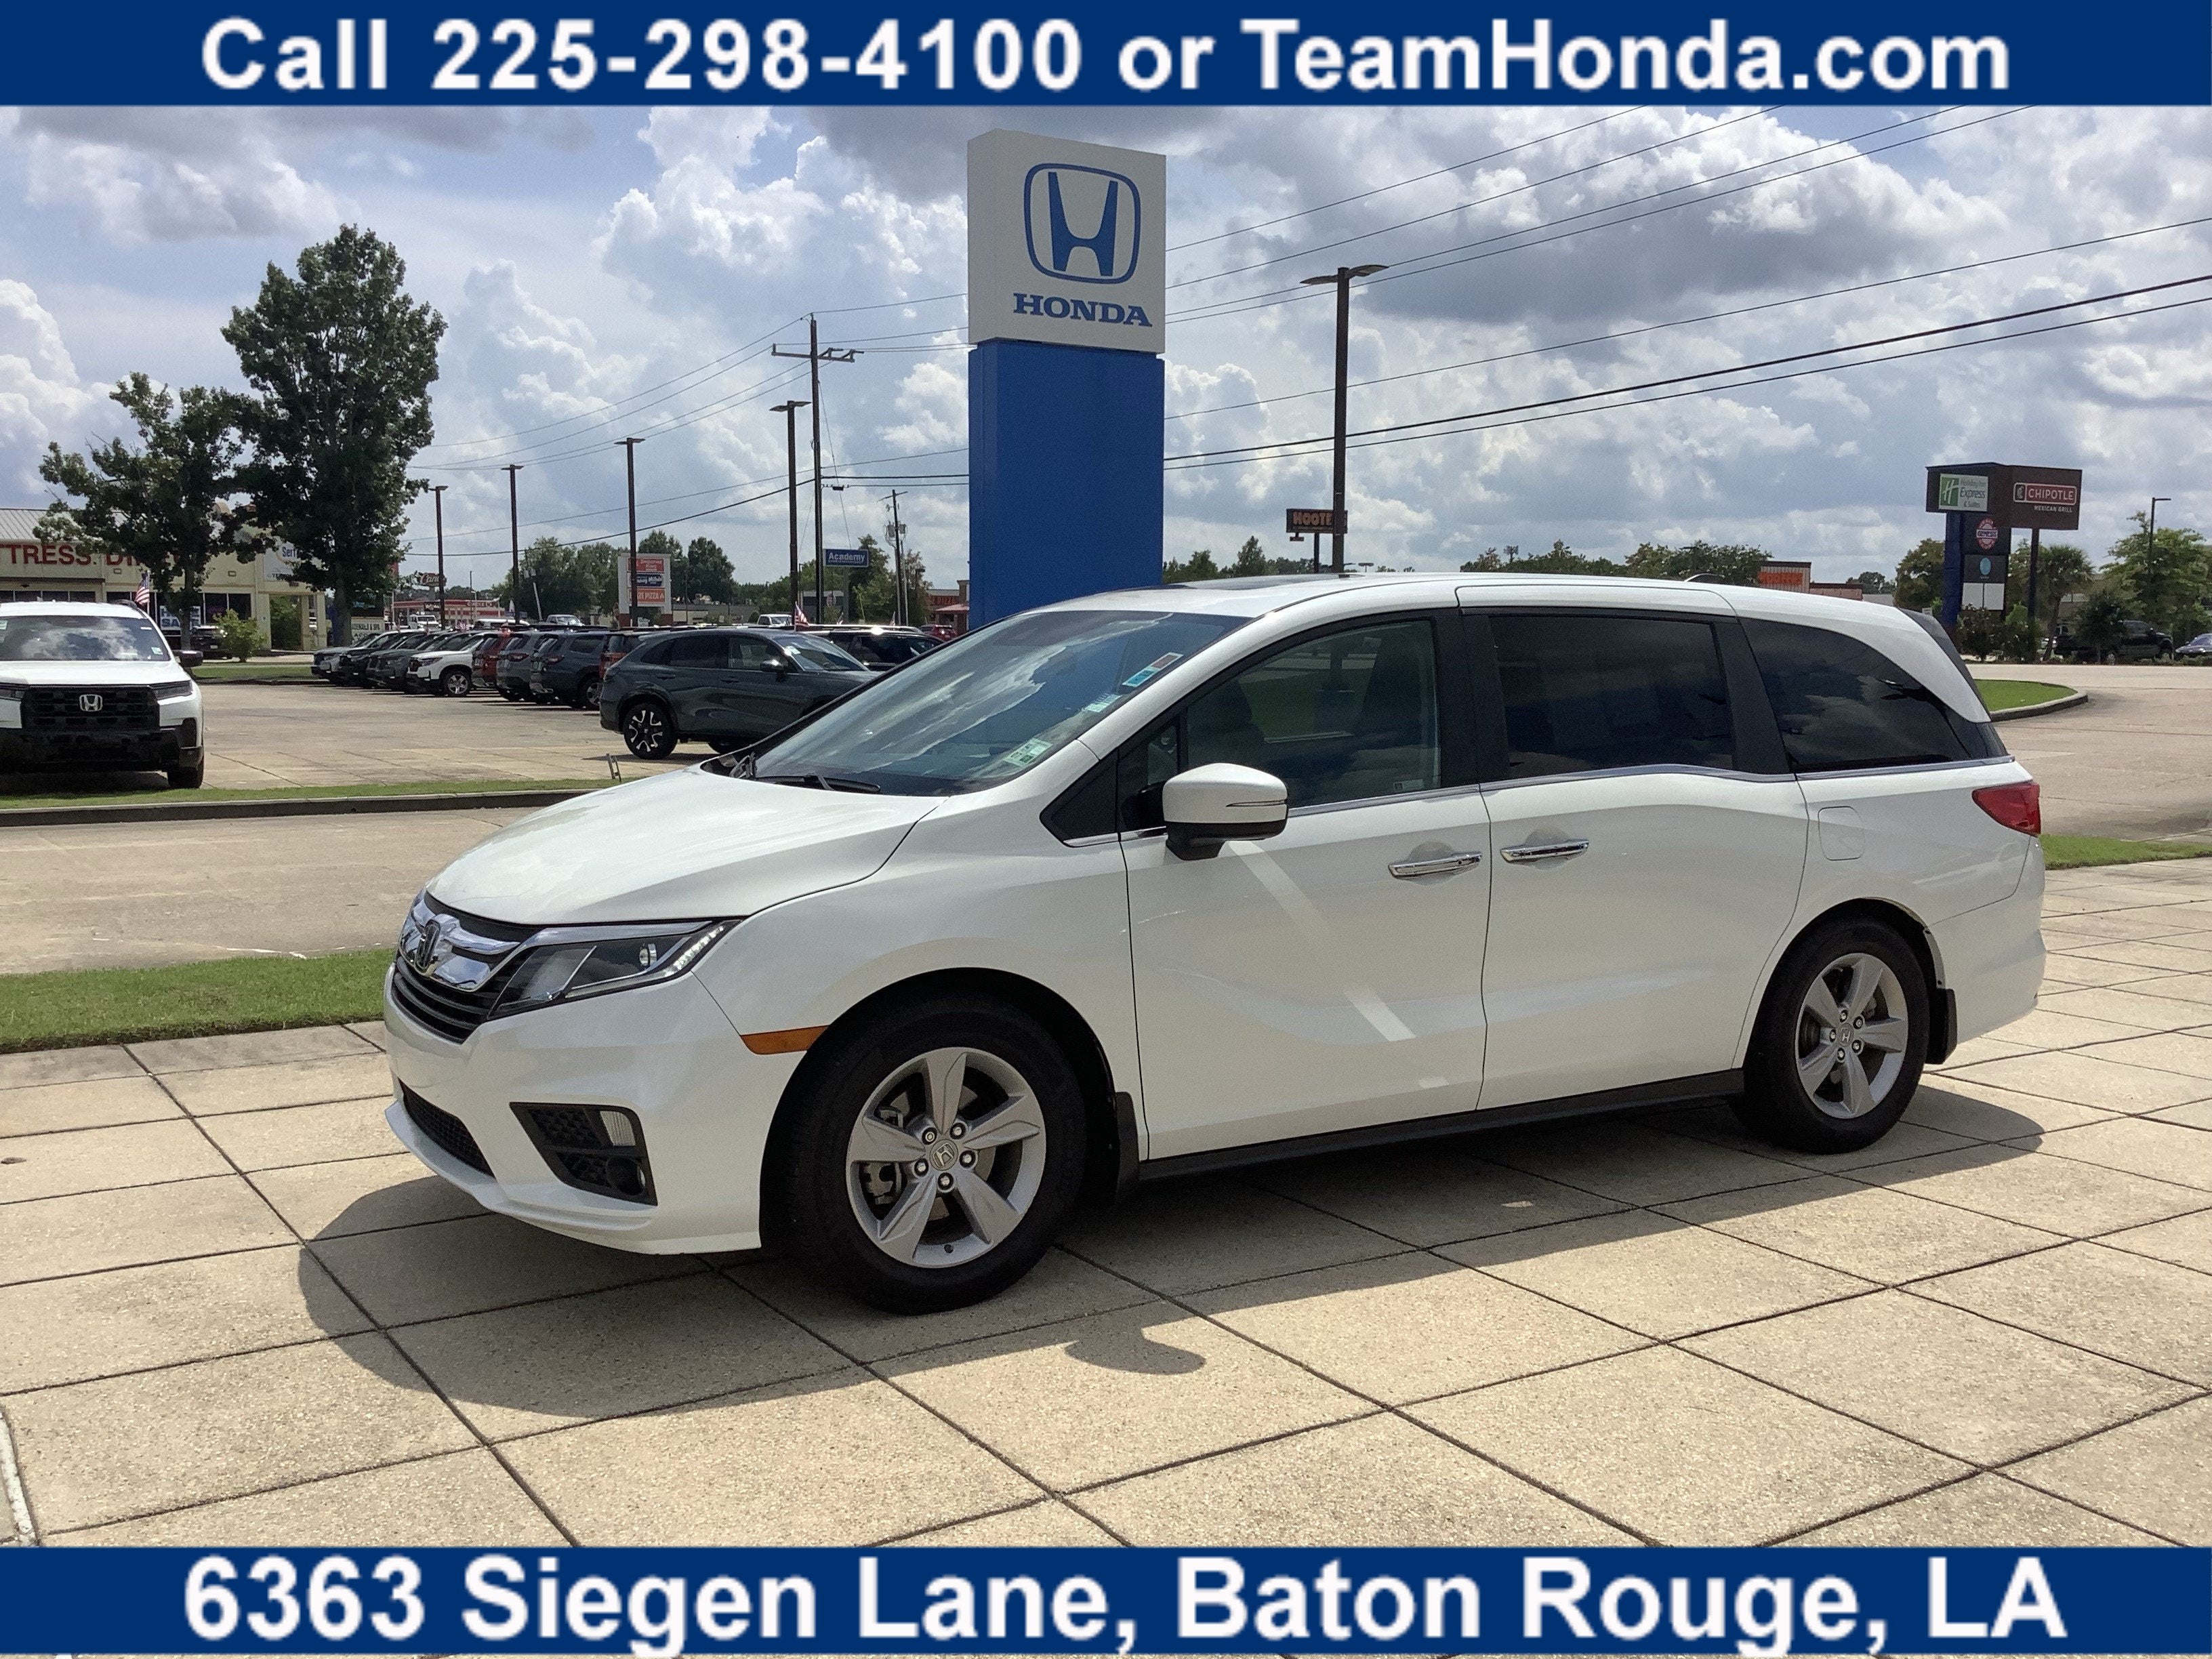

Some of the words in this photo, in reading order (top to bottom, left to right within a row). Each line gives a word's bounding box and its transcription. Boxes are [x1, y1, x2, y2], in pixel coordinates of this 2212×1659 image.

[1013, 293, 1153, 327] HONDA
[1960, 487, 1986, 500] Express
[2028, 489, 2074, 500] CHIPOTLE
[1292, 511, 1334, 526] HOOTE
[0, 544, 91, 565] TRESS
[828, 552, 865, 563] Academy
